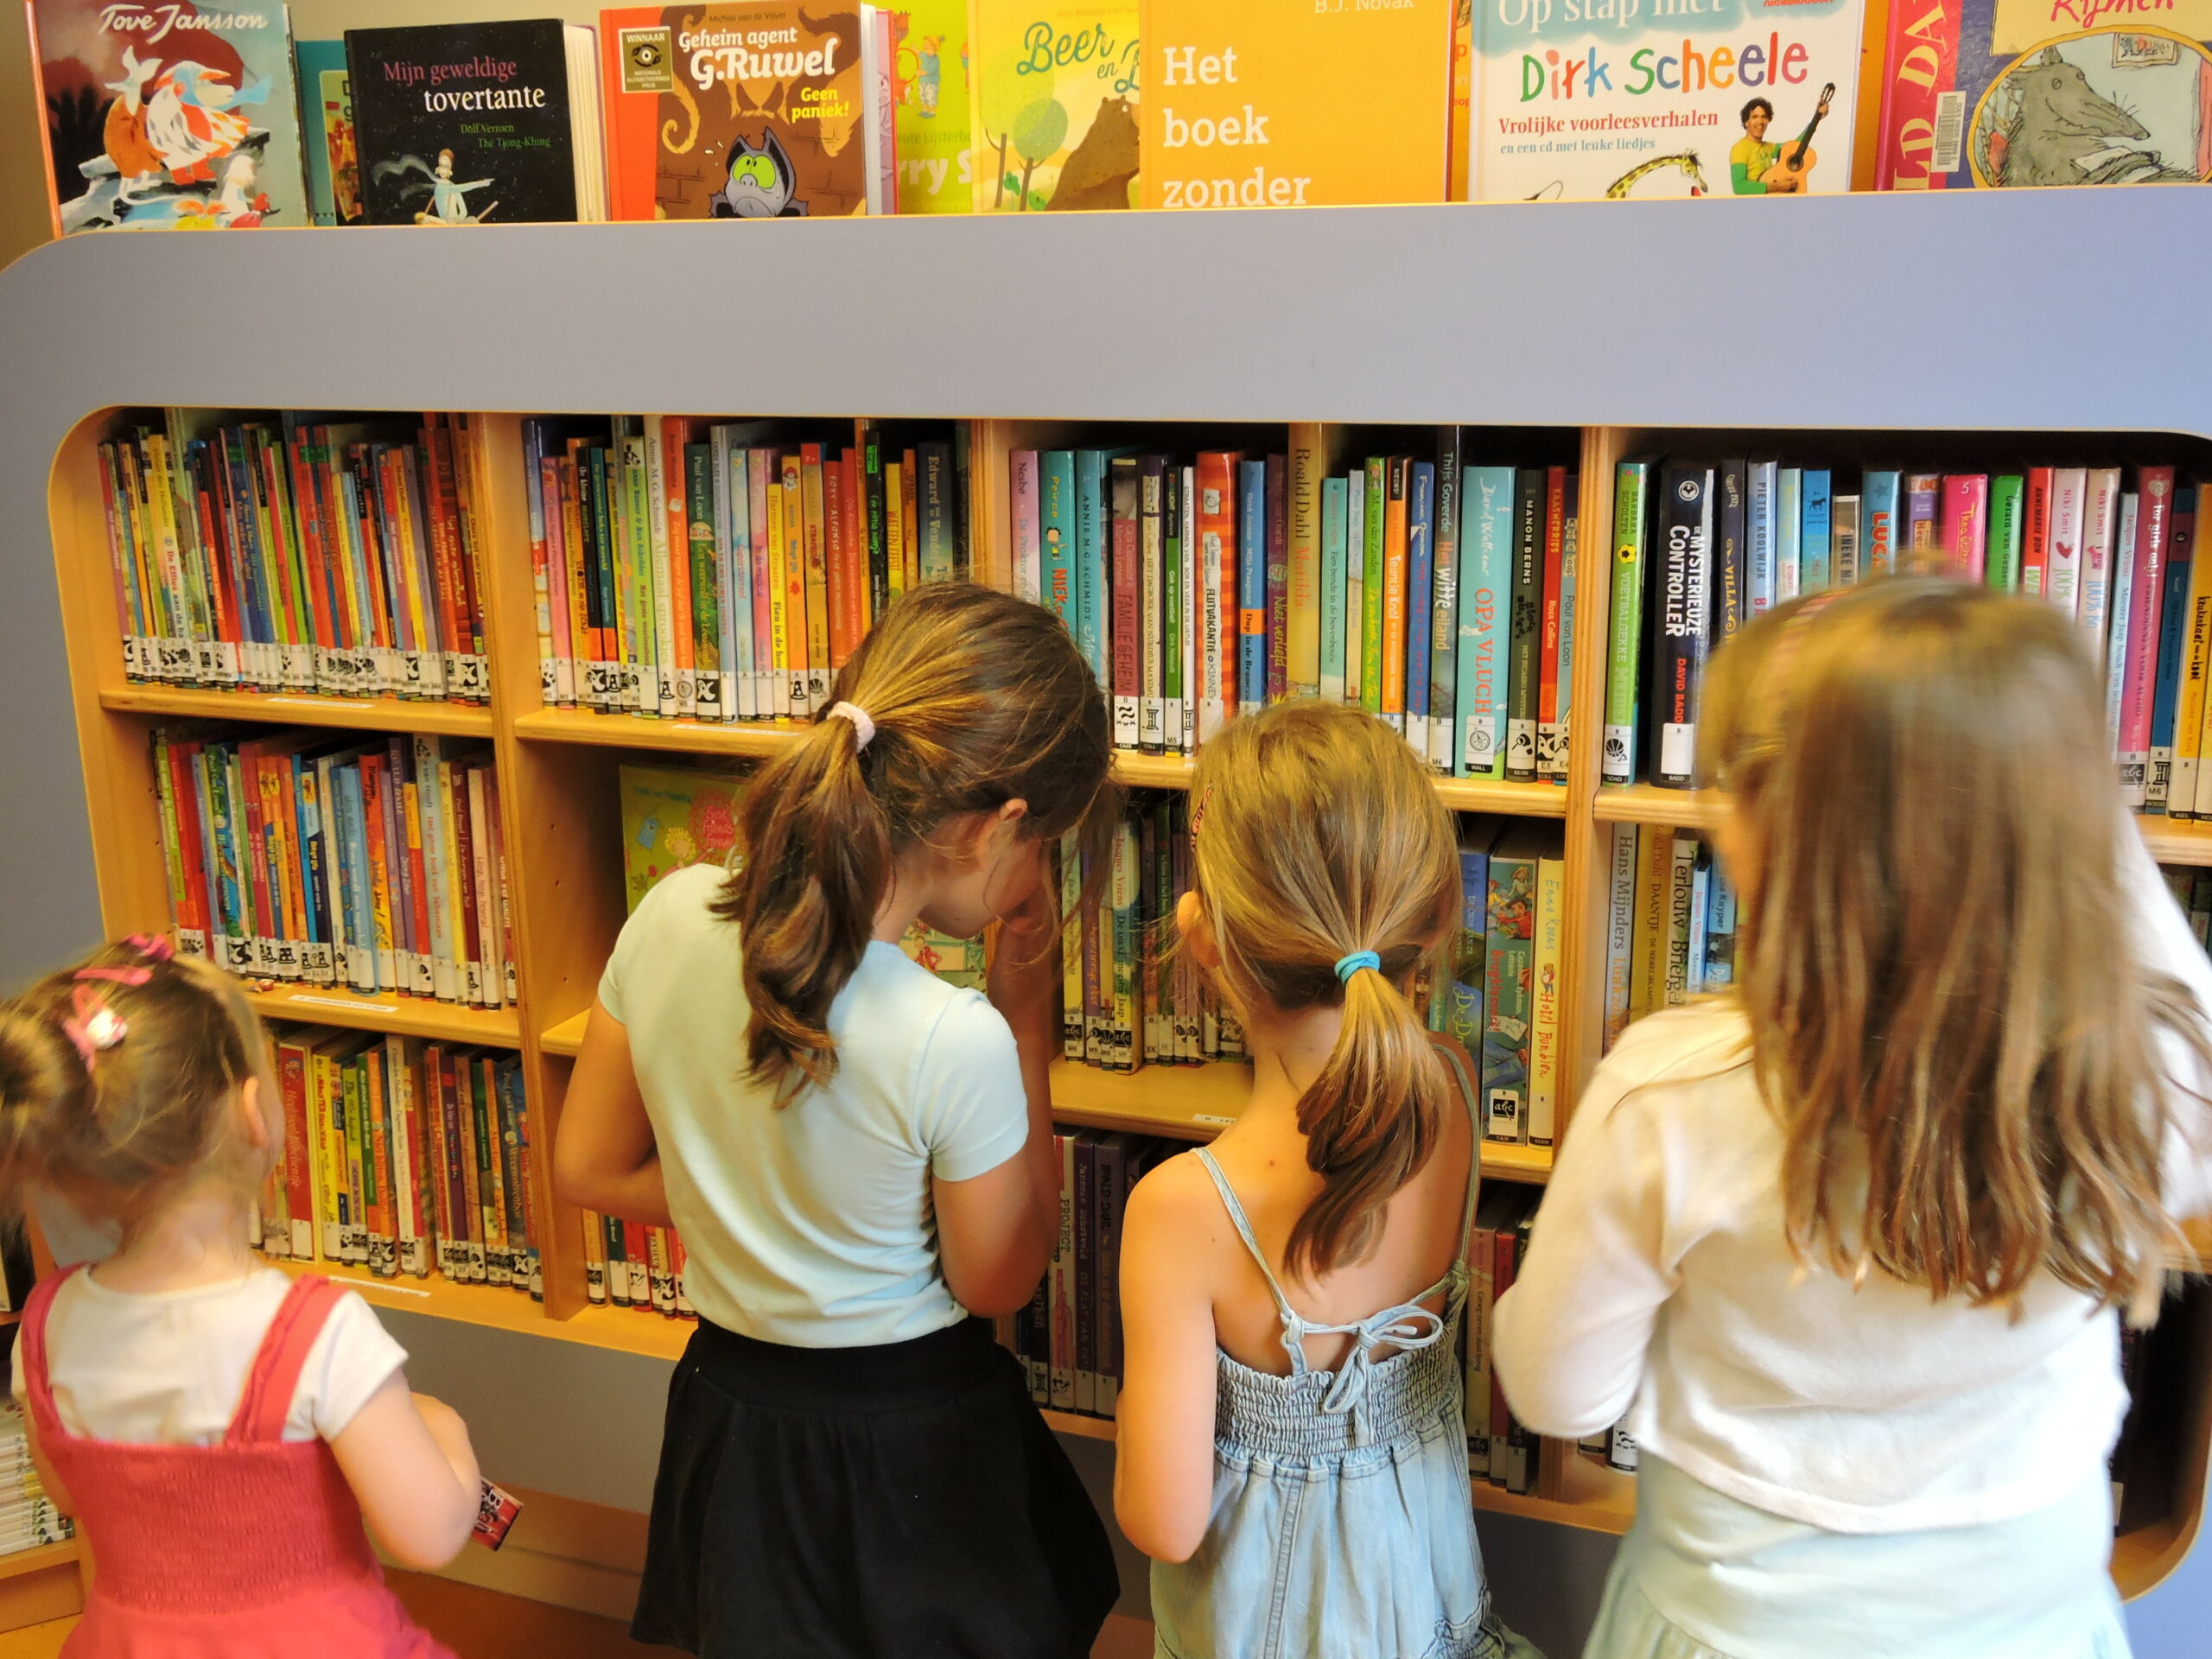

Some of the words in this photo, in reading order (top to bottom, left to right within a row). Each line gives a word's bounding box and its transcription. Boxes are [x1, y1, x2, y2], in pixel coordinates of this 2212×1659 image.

[99, 3, 158, 36] Tove
[146, 2, 269, 44] Jansson
[765, 12, 785, 21] Vijver
[1498, 0, 1552, 33] Op
[1564, 0, 1638, 29] stap
[626, 34, 665, 43] WINNAAR
[679, 29, 743, 53] Geheim
[747, 27, 798, 49] agent
[1016, 21, 1115, 76] Beer
[384, 61, 424, 86] Mijn
[430, 56, 517, 84] geweldige
[690, 38, 839, 90] G.Ruwel
[1097, 62, 1118, 79] en
[1163, 47, 1237, 86] Het
[1520, 46, 1612, 103] Dirk
[1624, 31, 1808, 95] Scheele
[424, 86, 546, 112] tovertante
[801, 87, 838, 102] Geen
[791, 101, 849, 123] paniek!
[1162, 105, 1269, 148] boek
[1498, 116, 1565, 137] Vrolijke
[1570, 110, 1719, 132] voorleesverhalen
[1500, 145, 1514, 154] en
[1516, 143, 1536, 153] een
[1539, 141, 1553, 153] cd
[1556, 142, 1577, 151] met
[1616, 137, 1656, 152] liedjes
[1163, 167, 1312, 207] zonder
[693, 456, 703, 474] Paul
[928, 456, 940, 505] Edward
[1017, 462, 1027, 494] Nesbø
[1295, 448, 1311, 496] Roald
[1441, 451, 1453, 480] Thijs
[1051, 476, 1060, 518] Peirce
[1372, 494, 1380, 506] M.
[1756, 481, 1767, 520] PIETER
[1961, 483, 1970, 494] 5
[2063, 489, 2072, 510] Niki
[2097, 489, 2107, 508] Niki
[696, 496, 706, 519] Loon
[770, 495, 779, 531] Harmen
[1295, 501, 1310, 539] Dahl
[1440, 483, 1453, 533] Goverde
[1523, 499, 1535, 543] MANON
[1619, 490, 1630, 535] SCHOLTEN
[1630, 491, 1638, 534] BARBARA
[2004, 495, 2013, 528] Gerard
[2033, 486, 2044, 536] ANNEMARIE
[2061, 512, 2071, 535] Smit
[1019, 518, 1028, 534] Dr.
[1371, 527, 1380, 540] der
[2096, 512, 2107, 536] Smit
[2123, 513, 2135, 547] Jacques
[168, 550, 175, 563] De
[392, 537, 403, 584] monsterfeest
[1020, 537, 1030, 575] Proktor
[1330, 551, 1338, 567] Een
[1370, 543, 1379, 575] Zanden
[1437, 541, 1451, 565] Het
[1756, 525, 1767, 580] KOOLWIJK
[1840, 534, 1853, 565] INEKE
[2033, 537, 2042, 554] BON
[168, 565, 178, 591] Effies
[655, 538, 669, 599] Allemaal
[772, 551, 781, 590] Straaten
[1522, 546, 1533, 585] BERNS
[2121, 550, 2132, 577] Vriens
[1052, 568, 1068, 604] NIEK
[1083, 567, 1091, 622] SCHMIDT
[1168, 586, 1175, 594] op
[1329, 569, 1338, 594] bende
[1434, 567, 1457, 609] witte
[1665, 525, 1690, 637] CONTROLLER
[1685, 535, 1705, 637] MYSTERIEUZE
[1725, 565, 1737, 607] VILLA
[176, 613, 183, 625] de
[1330, 605, 1338, 615] de
[1474, 588, 1494, 632] OPA
[1548, 601, 1556, 620] Ross
[1564, 595, 1574, 618] Paul
[1617, 571, 1631, 663] VOETBALGEKKE
[2117, 587, 2129, 620] Meester
[657, 602, 671, 664] sprookjes
[1185, 615, 1190, 625] DE
[1206, 588, 1217, 653] FLUTVAKANTIE
[1434, 610, 1450, 650] eiland
[1547, 621, 1556, 649] Collins
[1564, 620, 1573, 638] van
[2115, 623, 2127, 643] Jaap
[1246, 647, 1252, 658] de
[1561, 640, 1573, 667] Loon
[2114, 645, 2125, 670] houdt
[1474, 639, 1494, 714] VLUCH
[1675, 658, 1687, 690] DAVID
[2113, 672, 2121, 689] van
[1675, 693, 1686, 723] BADD
[2147, 787, 2162, 796] M6
[1115, 838, 1125, 873] Jacques
[1617, 836, 1633, 876] Hans
[1116, 876, 1124, 906] Vriens
[1544, 879, 1560, 913] Enne
[1672, 851, 1694, 928] Terlouw
[1694, 891, 1703, 918] Jacques
[1116, 916, 1126, 930] De
[1613, 880, 1630, 950] Mijnders
[1716, 894, 1727, 928] Kuyper
[1545, 918, 1562, 950] Koens
[1114, 995, 1127, 1018] Jaap
[1060, 1198, 1071, 1253] PROJECT
